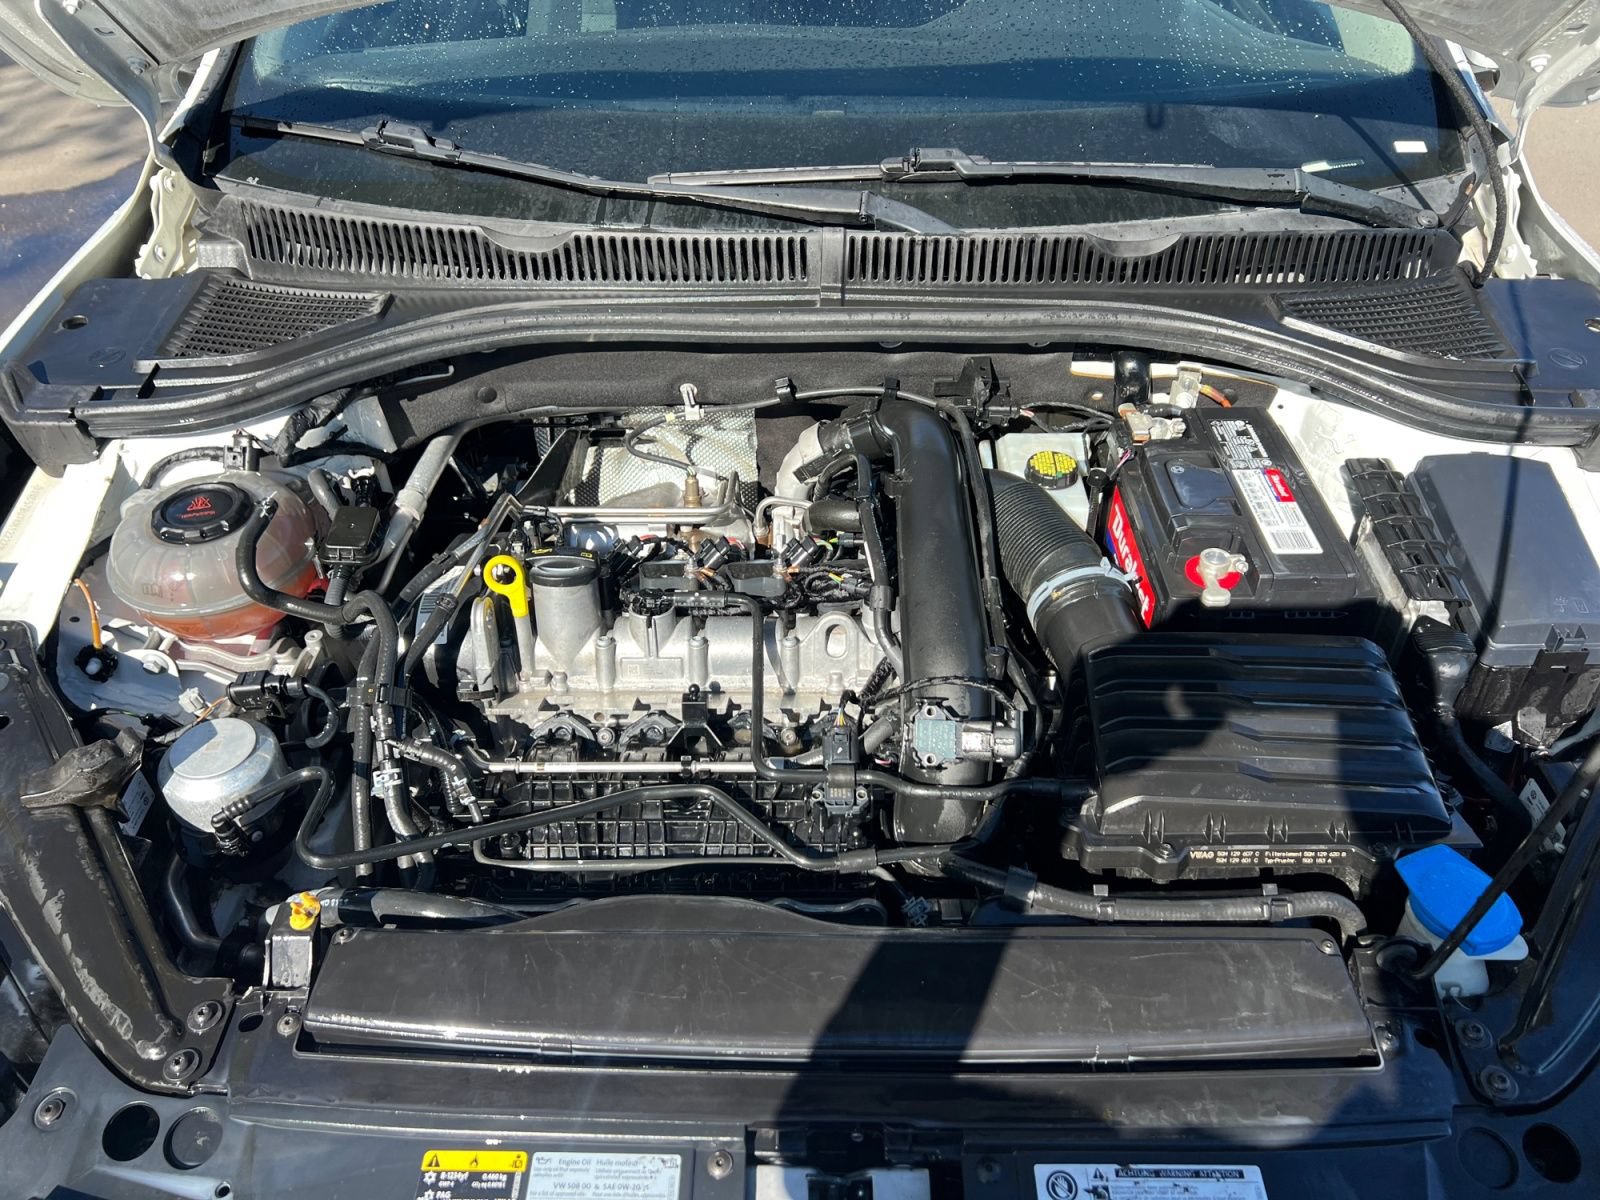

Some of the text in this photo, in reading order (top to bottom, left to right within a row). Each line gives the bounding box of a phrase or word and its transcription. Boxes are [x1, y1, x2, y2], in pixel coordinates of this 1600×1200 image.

[1112, 503, 1150, 621] Duralst
[558, 1158, 593, 1167] Engine Oil
[553, 1181, 566, 1190] VW
